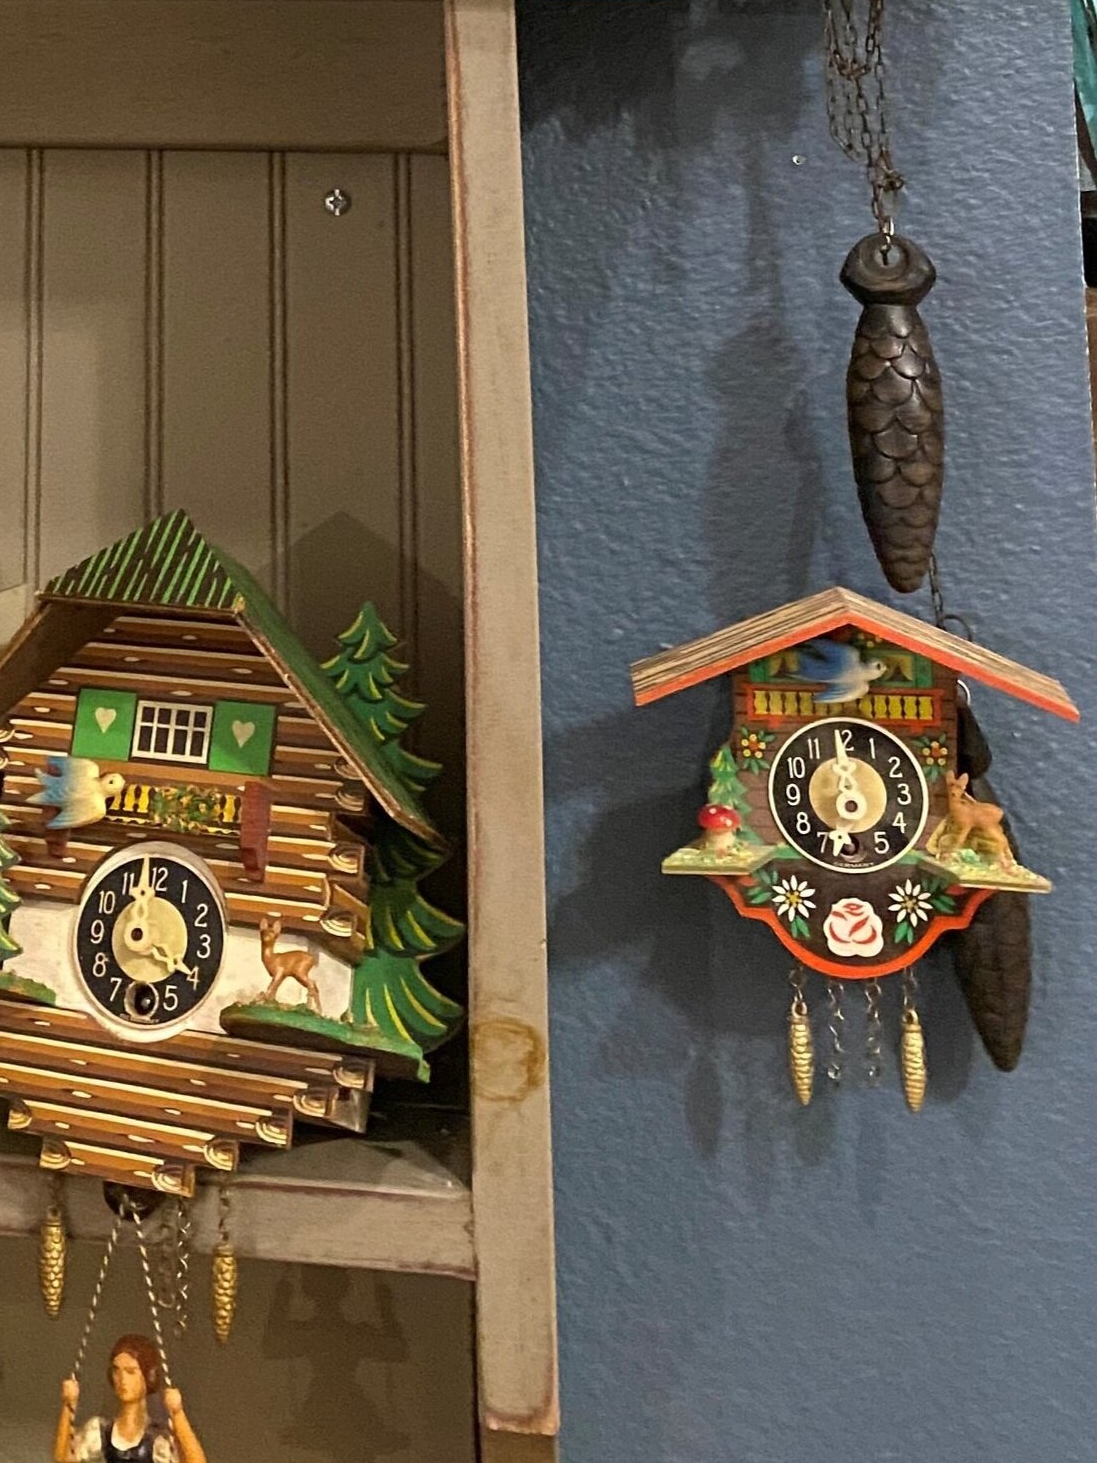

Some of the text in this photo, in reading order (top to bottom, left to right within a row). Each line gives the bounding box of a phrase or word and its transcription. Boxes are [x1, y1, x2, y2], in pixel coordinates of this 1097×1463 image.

[807, 738, 821, 760] 11
[869, 737, 876, 759] 1
[787, 757, 806, 779] 10
[888, 756, 903, 778] 2
[786, 783, 801, 807] 9
[897, 783, 912, 806] 3
[796, 812, 811, 834] 8
[892, 811, 907, 834] 4
[817, 832, 830, 853] 7
[874, 831, 890, 854] 5
[122, 872, 135, 896] 11
[152, 867, 169, 892] 12
[181, 879, 188, 904] 1
[98, 890, 116, 915] 10
[194, 903, 209, 928] 2
[90, 919, 105, 945] 9
[197, 933, 211, 959] 3
[92, 952, 107, 978] 8
[109, 977, 123, 1002] 7
[186, 966, 200, 991] 4
[162, 985, 178, 1011] 5
